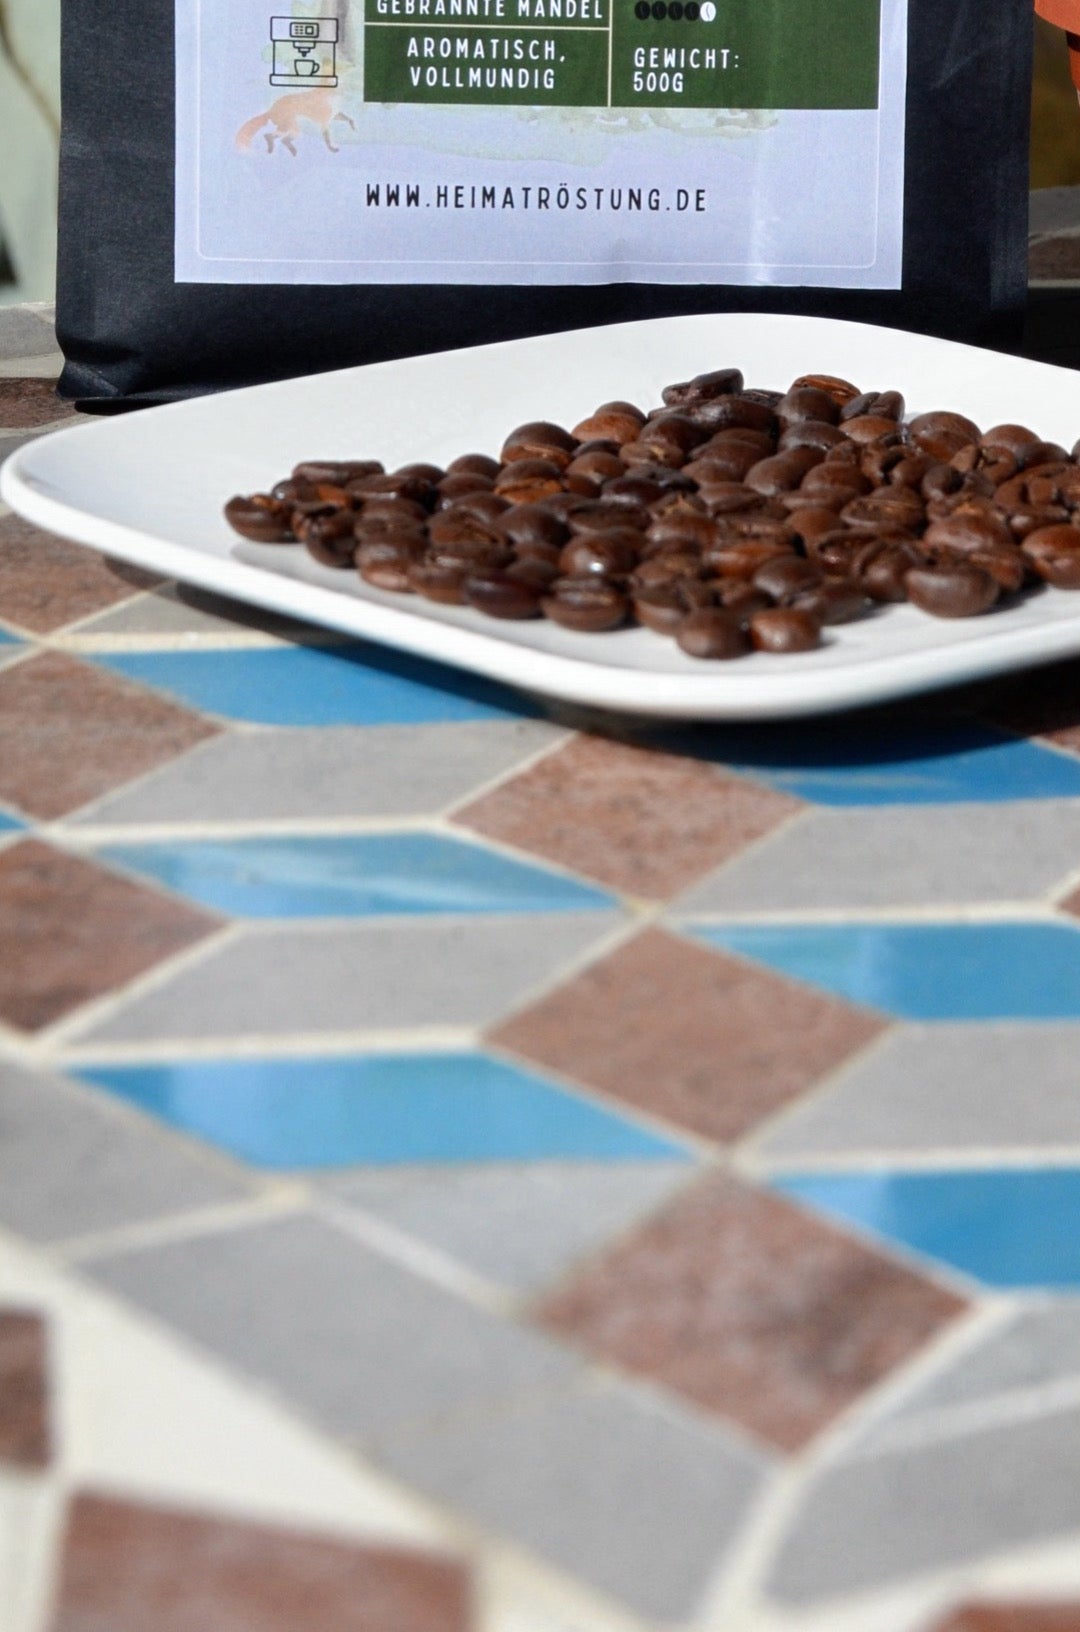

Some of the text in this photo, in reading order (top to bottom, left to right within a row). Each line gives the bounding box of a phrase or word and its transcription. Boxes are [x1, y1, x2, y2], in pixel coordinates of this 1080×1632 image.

[407, 37, 566, 63] AROMATISCH,
[634, 47, 740, 69] GEWICHT:
[410, 66, 555, 89] VOLLMUNDIG
[633, 71, 684, 92] 500G
[365, 182, 706, 212] WWW.HEIMATRÖSTUNG.DE
